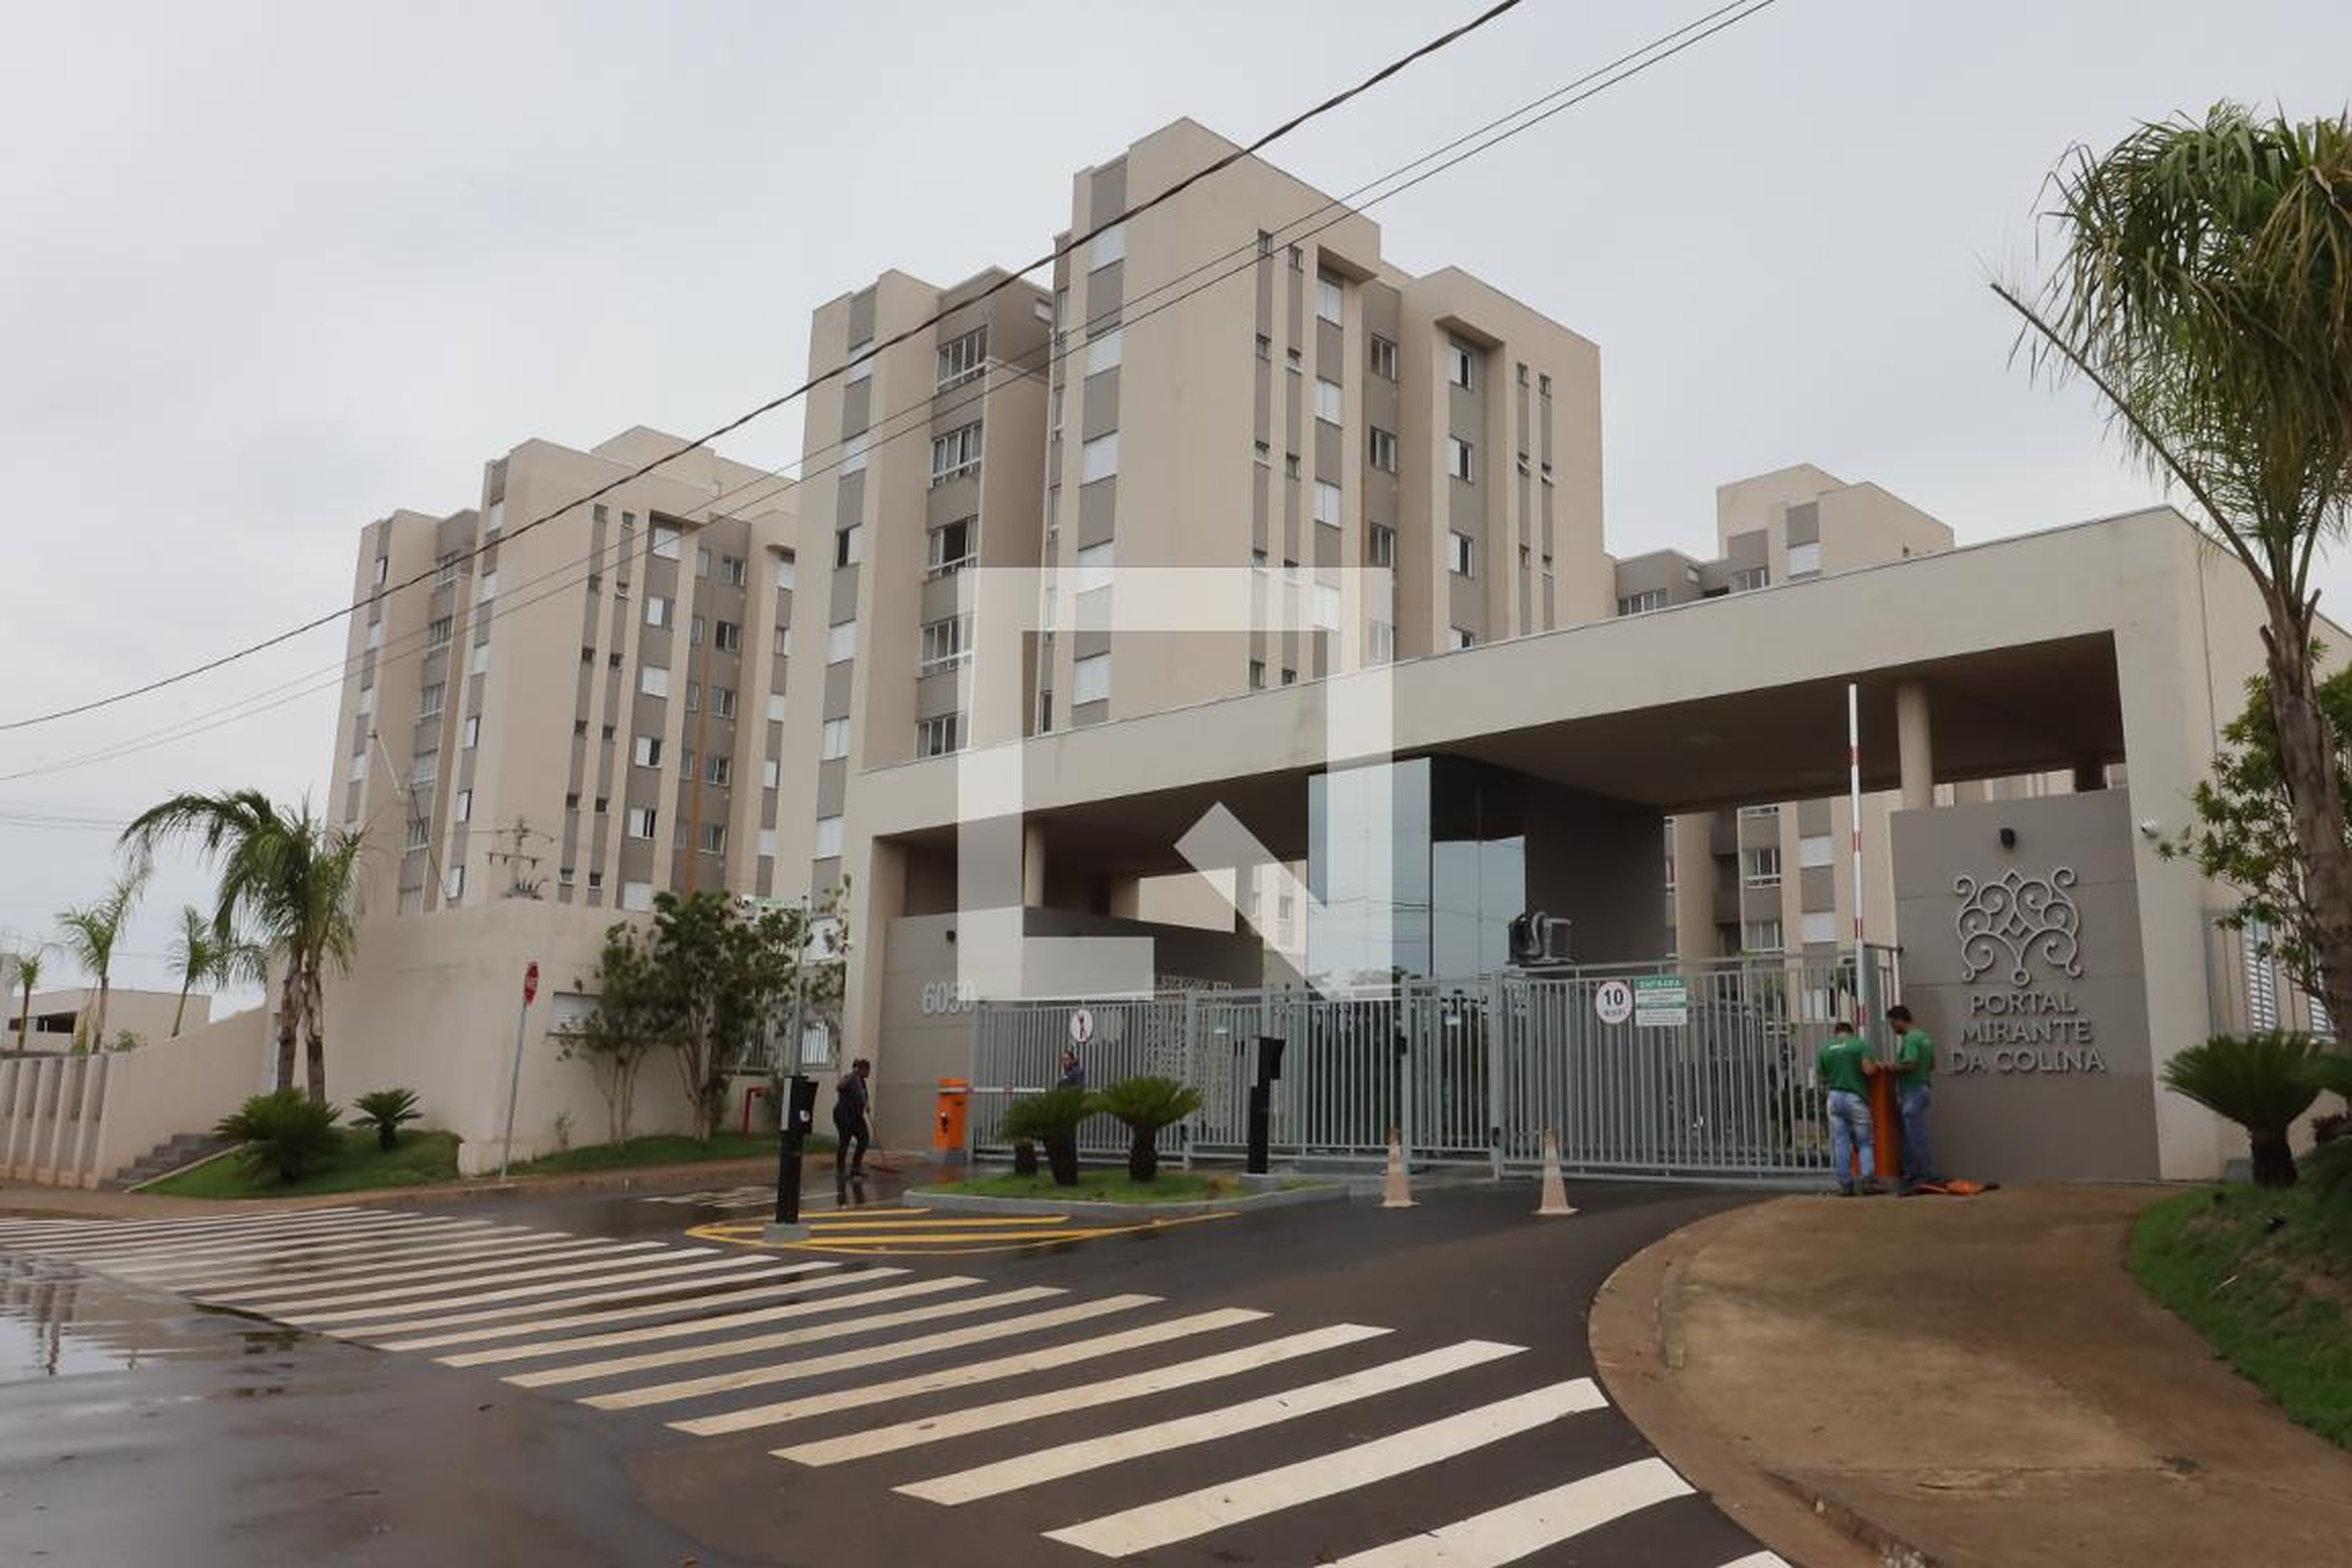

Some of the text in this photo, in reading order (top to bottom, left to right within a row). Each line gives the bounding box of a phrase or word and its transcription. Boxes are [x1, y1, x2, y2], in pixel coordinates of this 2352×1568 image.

[1604, 989, 1623, 1005] 10
[1970, 991, 2077, 1014] PORTAL
[1961, 1019, 2092, 1044] MIRANTE
[1950, 1045, 2106, 1073] DA COLINA
